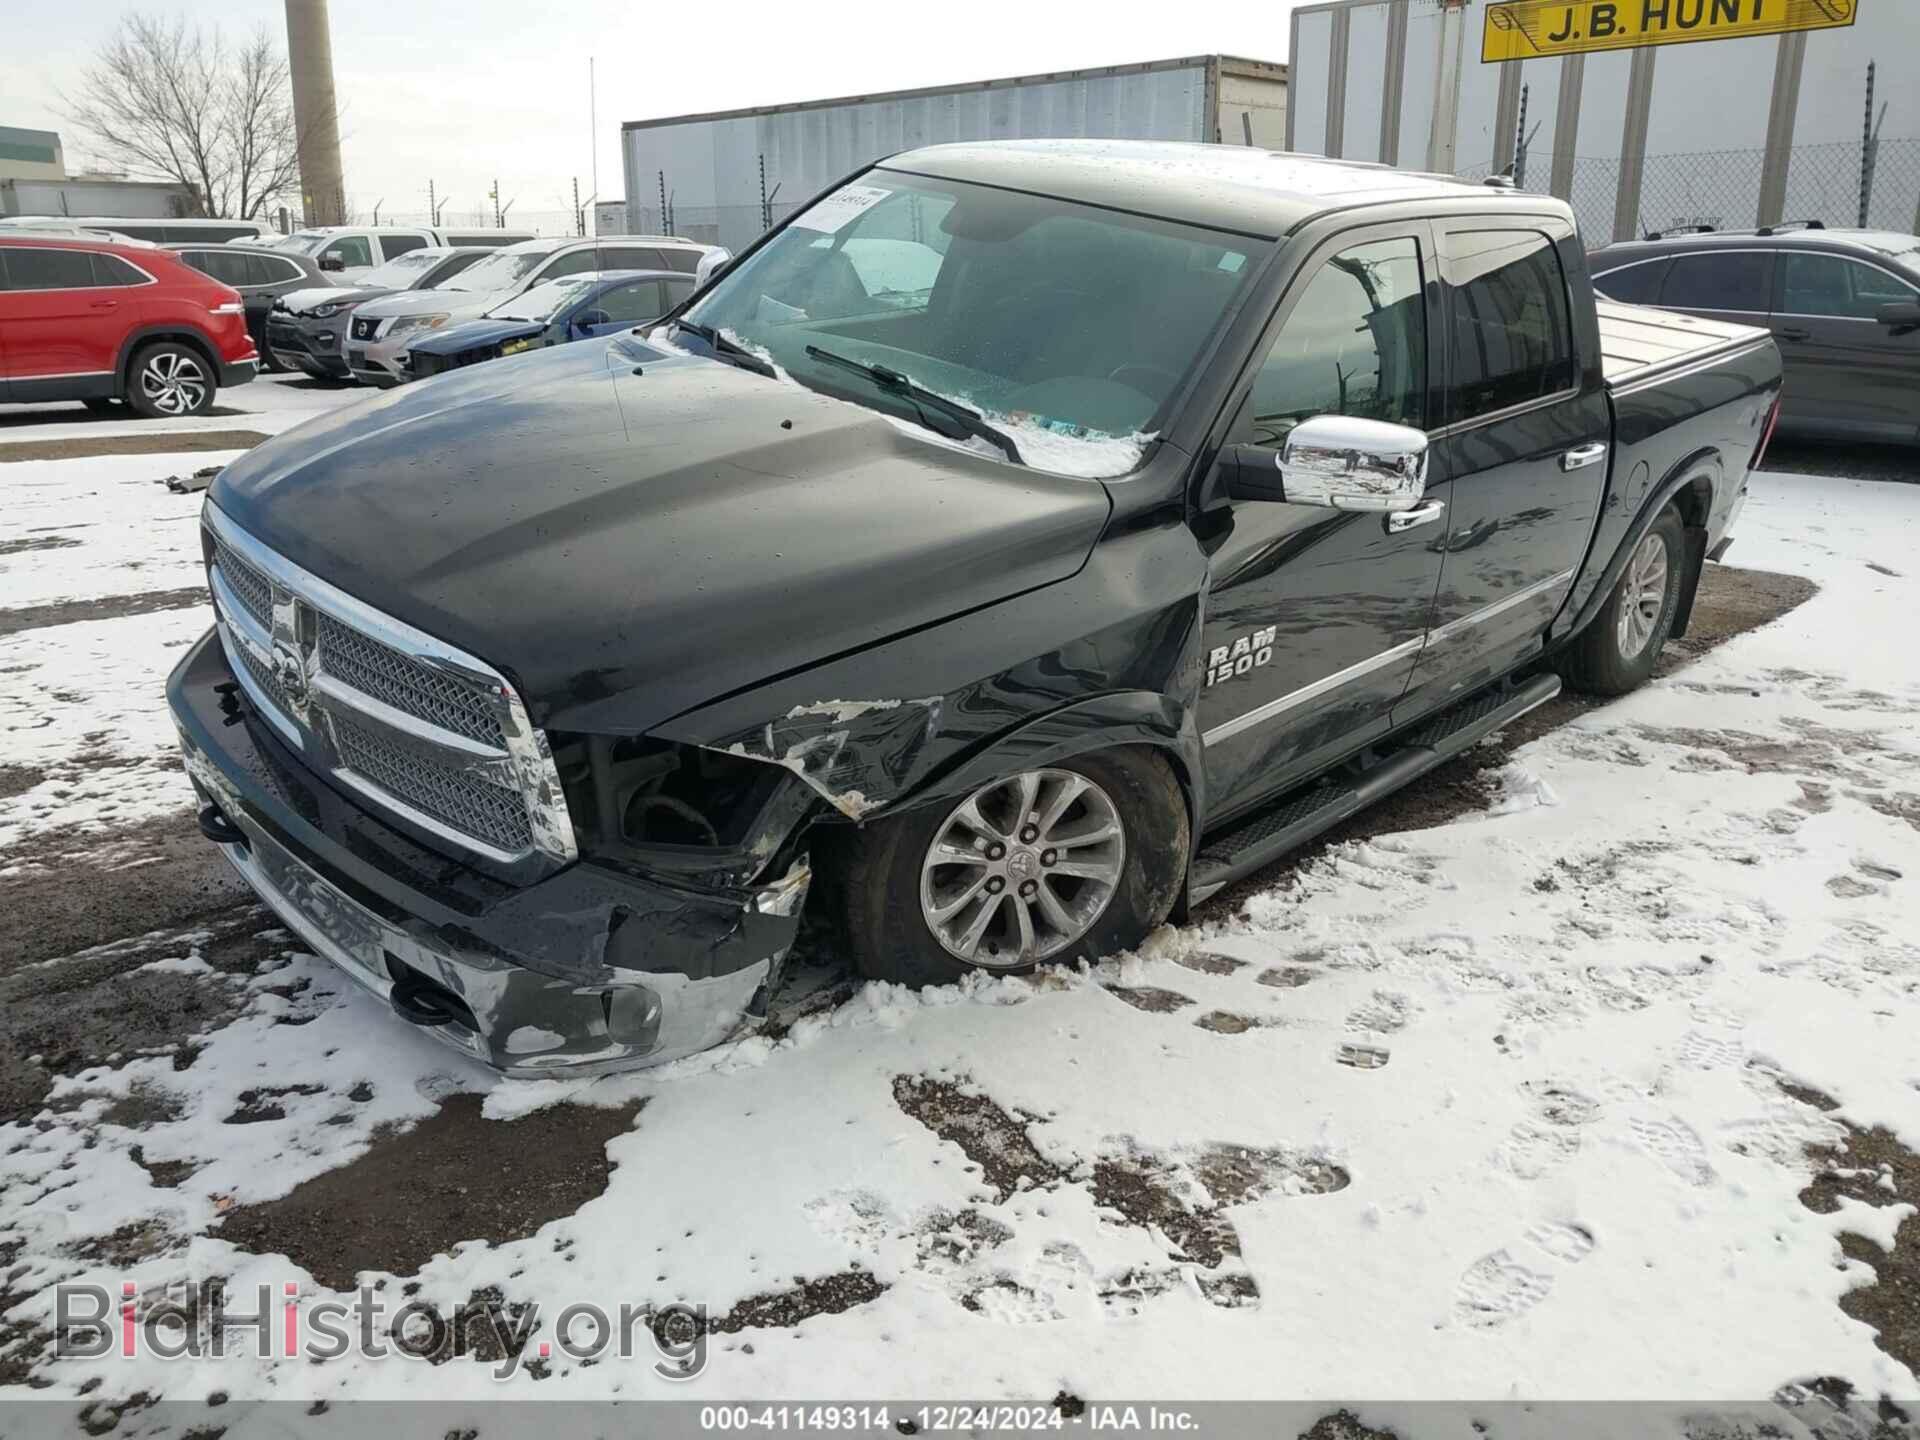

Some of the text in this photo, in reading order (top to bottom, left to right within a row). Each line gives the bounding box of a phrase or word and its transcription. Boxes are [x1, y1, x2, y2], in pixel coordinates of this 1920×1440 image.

[1548, 3, 1626, 42] J.B.
[1207, 646, 1272, 688] 1500
[1208, 625, 1277, 669] RAM
